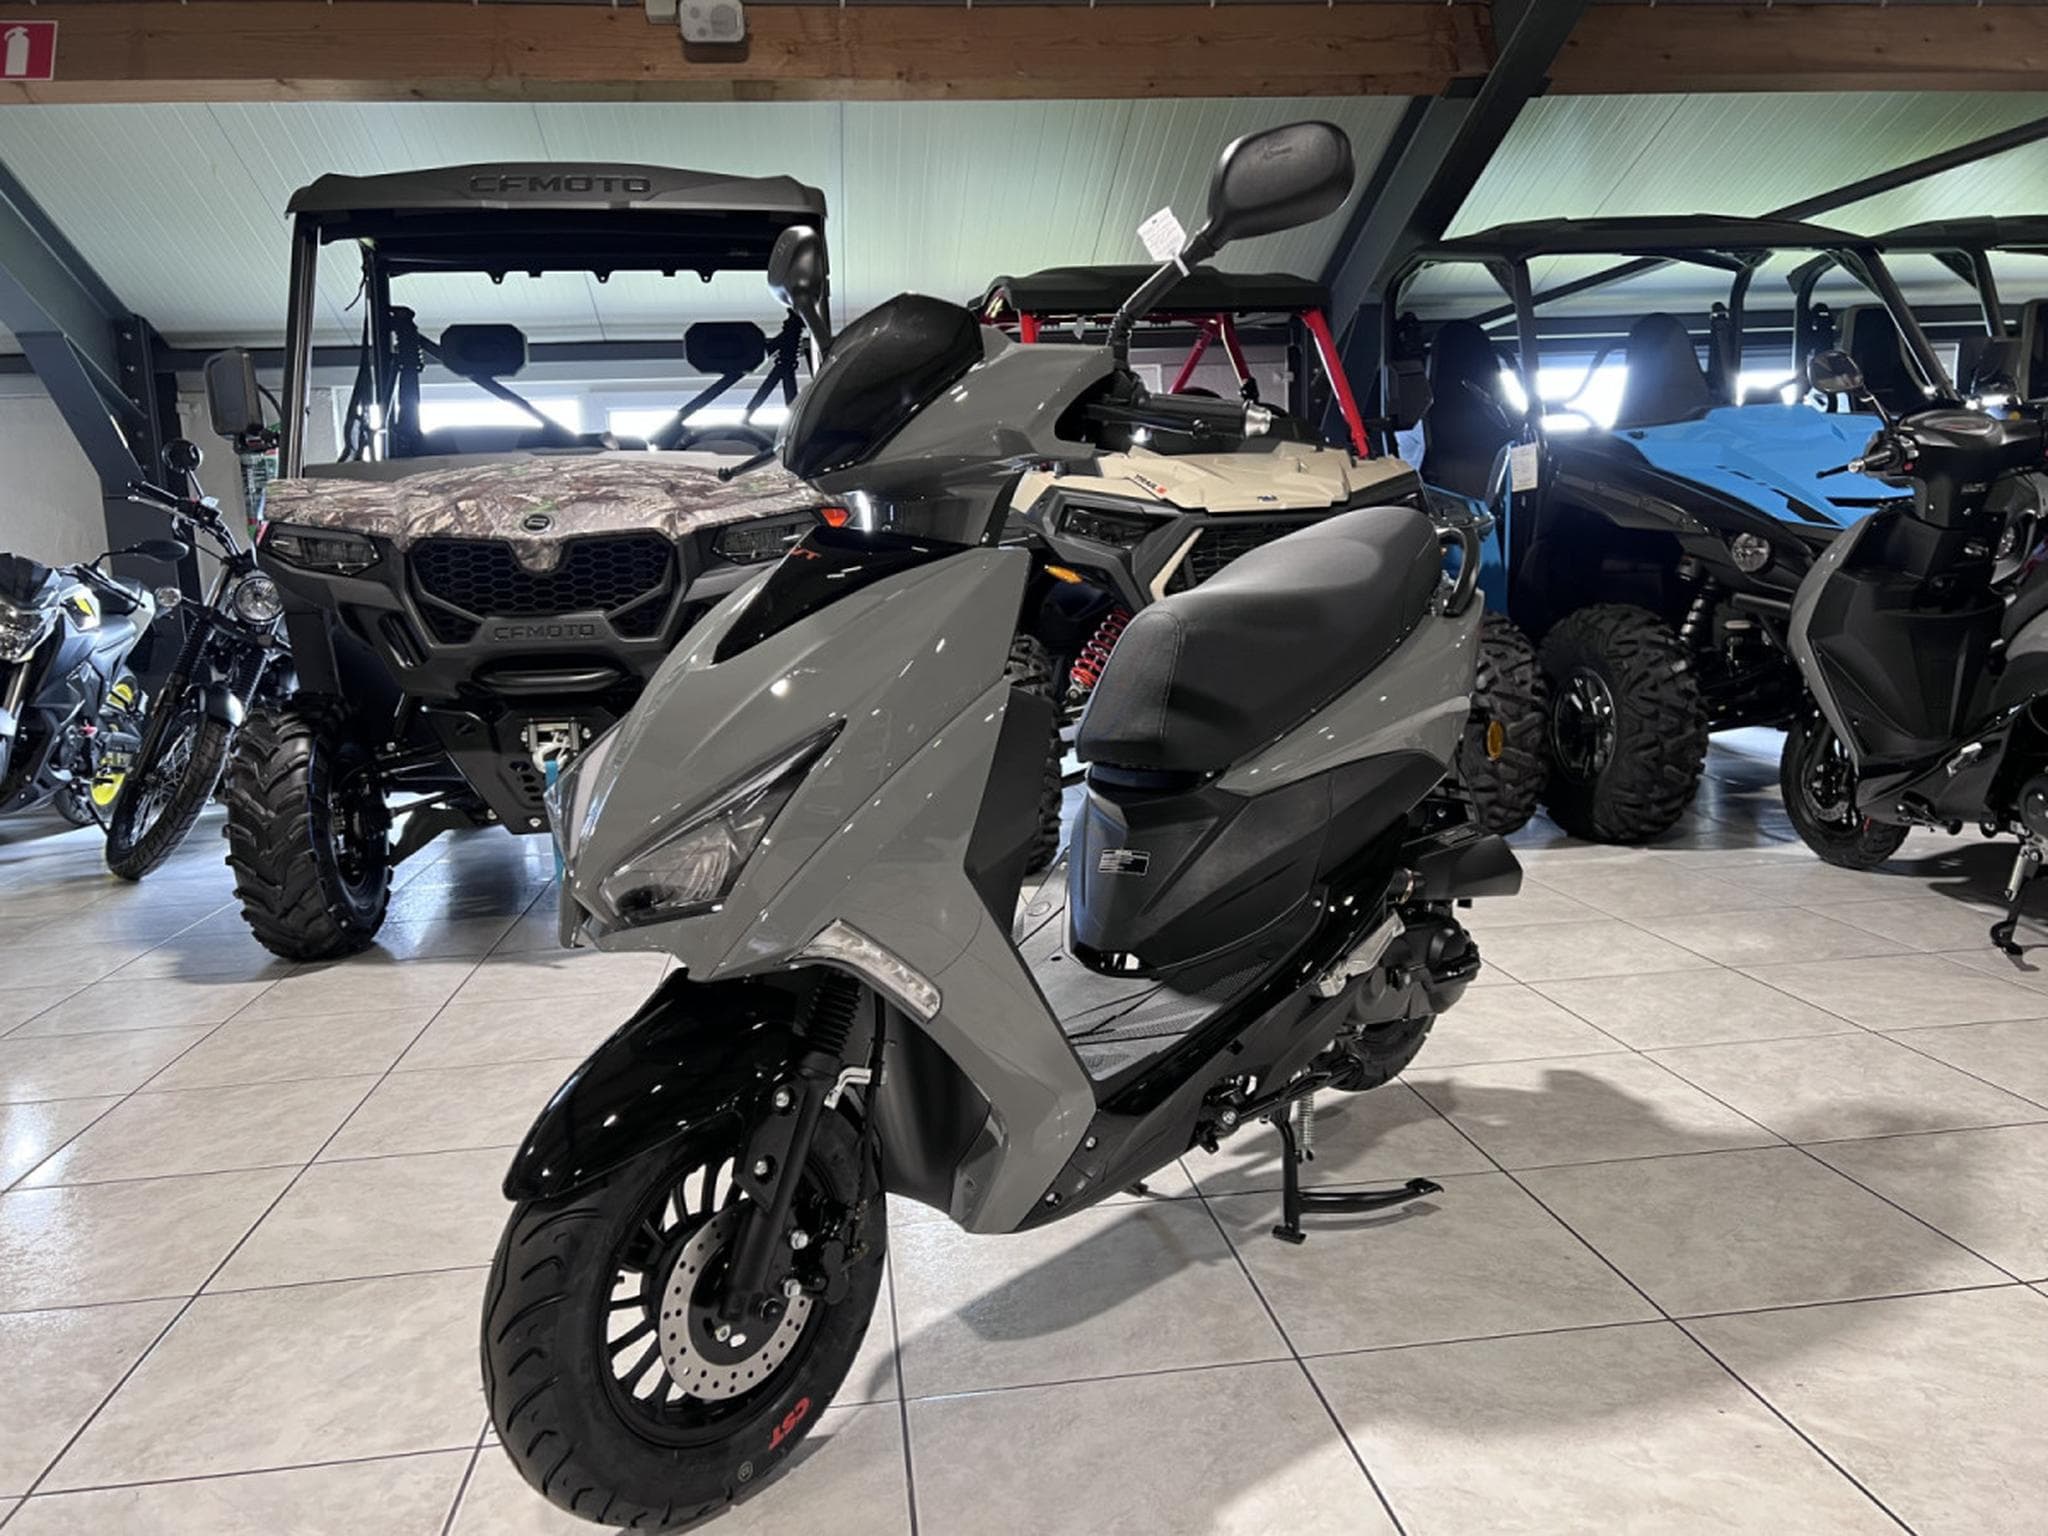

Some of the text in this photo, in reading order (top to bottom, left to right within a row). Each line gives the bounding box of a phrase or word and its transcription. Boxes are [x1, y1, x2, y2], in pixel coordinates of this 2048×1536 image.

[469, 174, 651, 193] CFMOTO
[494, 623, 594, 640] CFMOTO
[768, 1397, 812, 1451] CST
